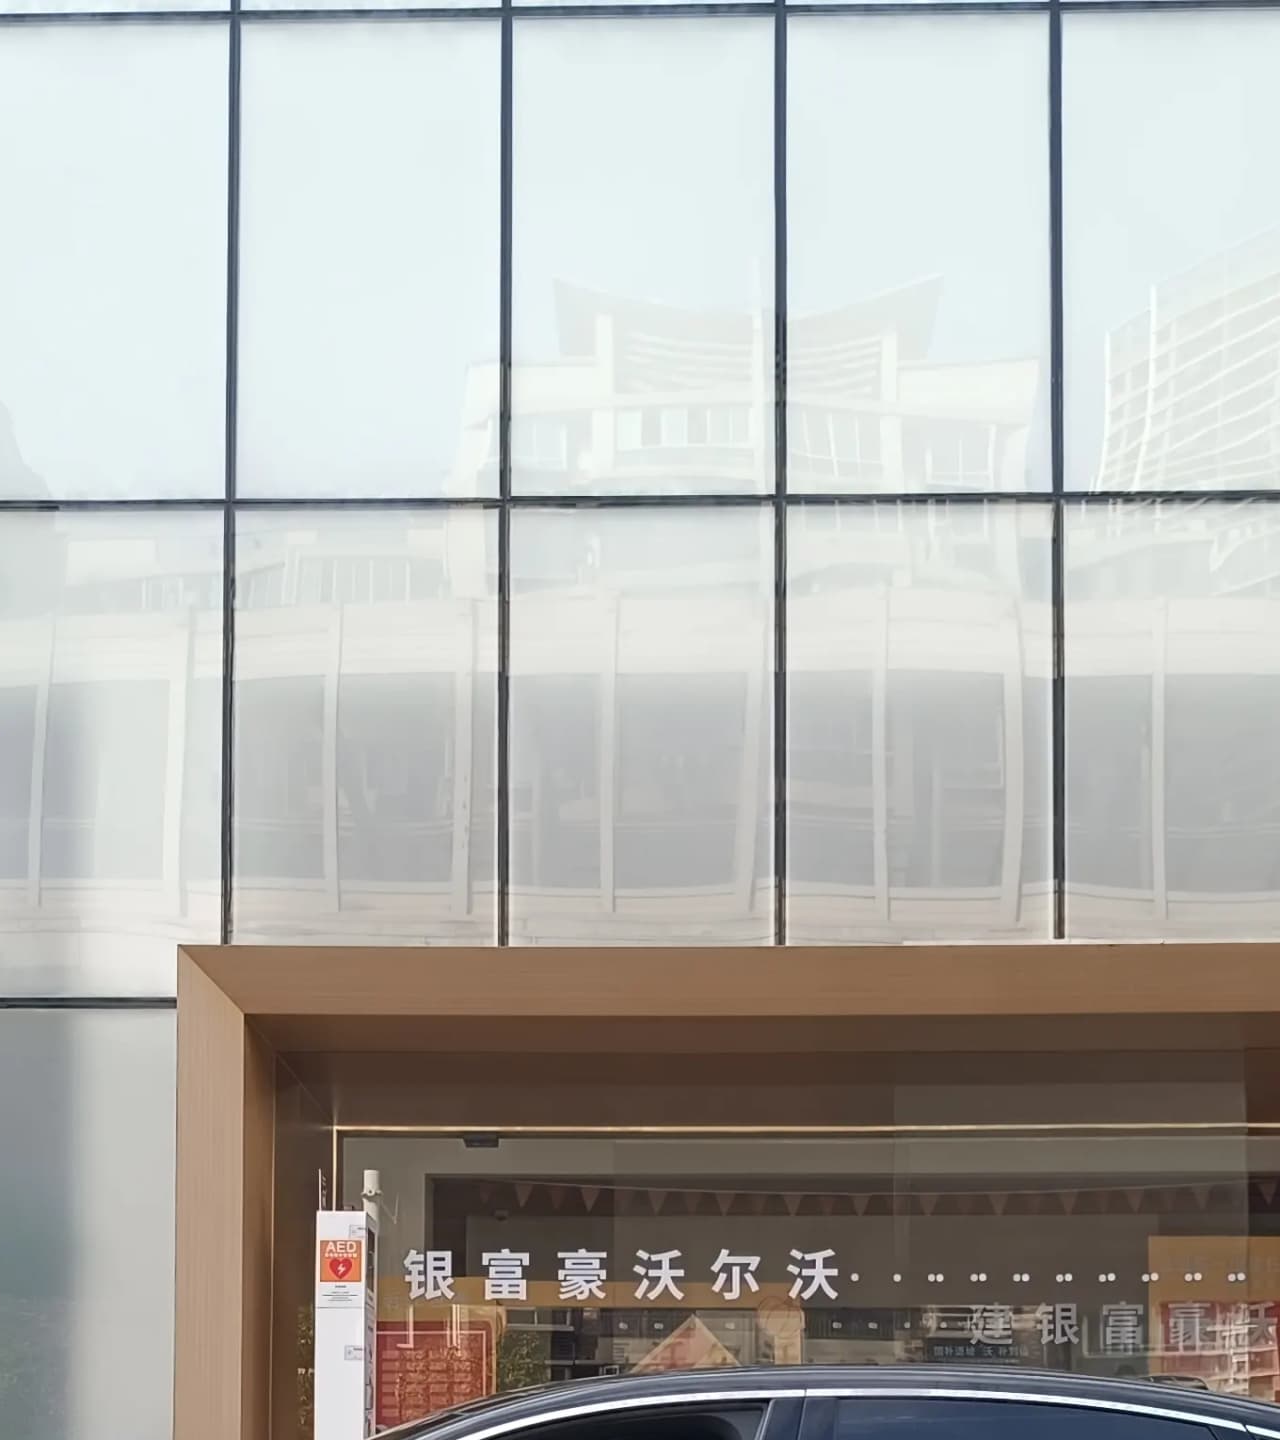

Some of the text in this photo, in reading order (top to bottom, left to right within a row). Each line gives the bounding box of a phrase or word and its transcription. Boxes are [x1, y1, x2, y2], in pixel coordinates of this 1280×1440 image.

[325, 1241, 356, 1252] AED
[403, 1248, 839, 1301] 银富豪沃尔沃
